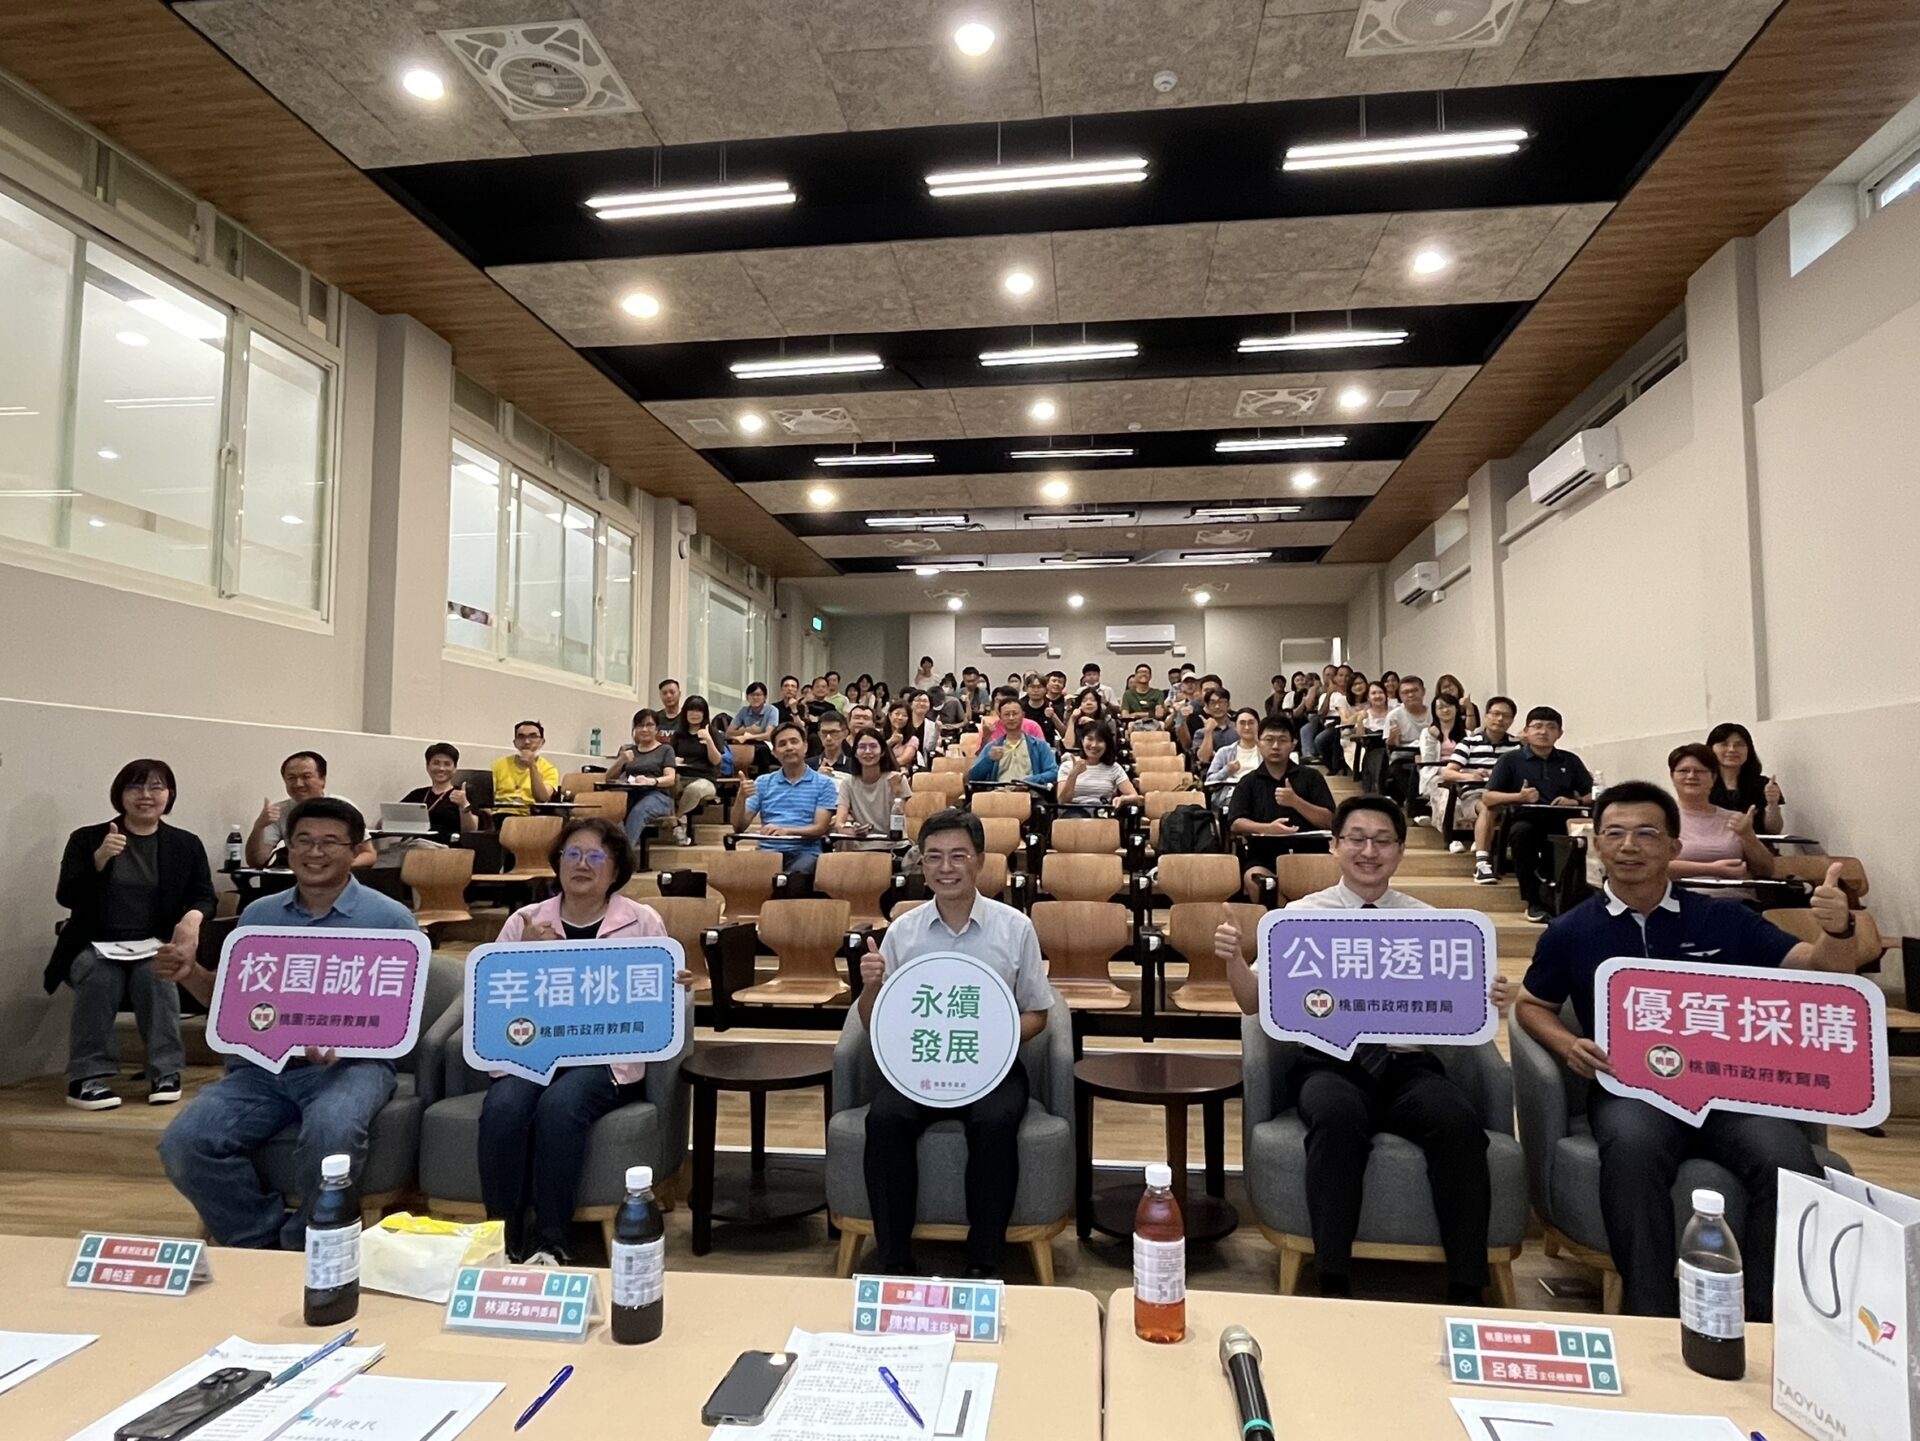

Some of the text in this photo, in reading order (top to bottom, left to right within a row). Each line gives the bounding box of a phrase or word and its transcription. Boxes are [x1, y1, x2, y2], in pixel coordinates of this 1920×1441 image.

[237, 952, 409, 998] 校園誠信
[1284, 936, 1474, 982] 公開透明
[487, 964, 664, 1010] 幸福桃園
[911, 983, 981, 1019] 永續
[1338, 996, 1454, 1014] 桃園市政府教育局
[279, 1013, 380, 1029] 桃園市政府教育局
[540, 1021, 645, 1040] 桃園市政府教育局
[1622, 986, 1858, 1054] 優質採購
[910, 1028, 980, 1065] 發展
[1688, 1058, 1831, 1091] 桃園市政府教育局
[1776, 1378, 1847, 1437] TAOYUAN
